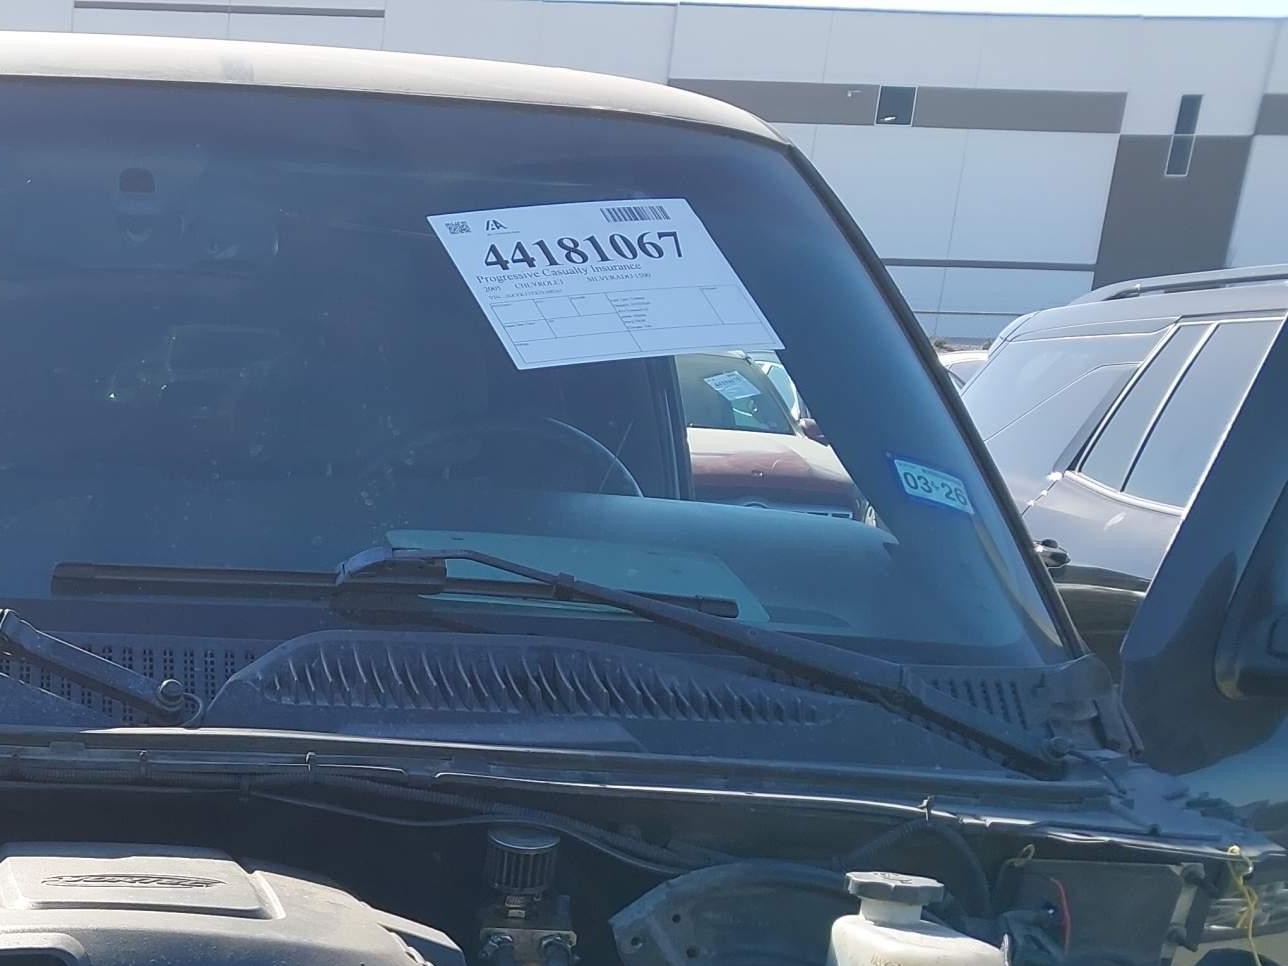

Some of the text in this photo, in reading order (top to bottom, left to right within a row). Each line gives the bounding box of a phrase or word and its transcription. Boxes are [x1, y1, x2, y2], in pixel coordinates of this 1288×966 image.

[484, 231, 683, 271] 44181067
[476, 262, 642, 284] Progressive Casualty Insurance
[904, 472, 933, 493] 03
[941, 482, 968, 506] 26
